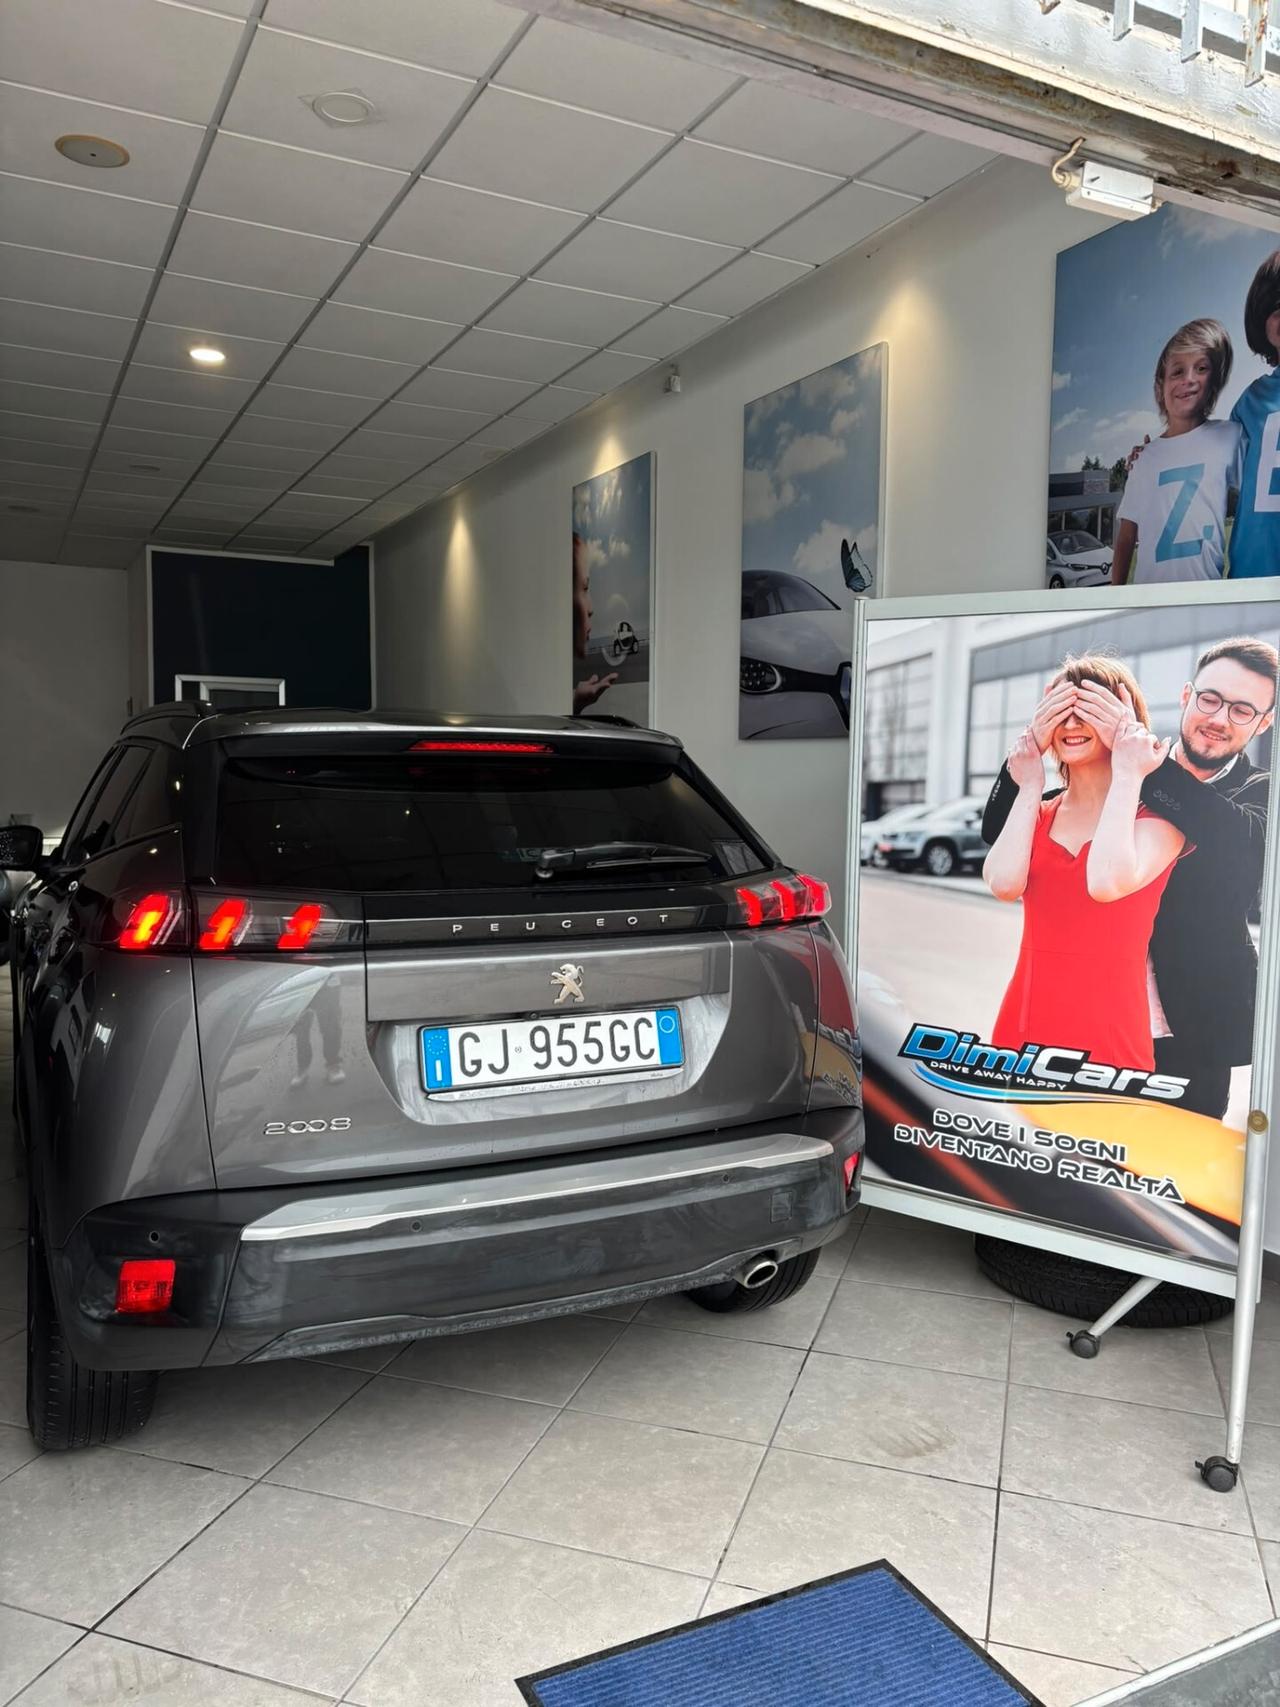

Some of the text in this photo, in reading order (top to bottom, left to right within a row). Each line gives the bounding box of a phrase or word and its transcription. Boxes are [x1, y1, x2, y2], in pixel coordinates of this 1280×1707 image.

[452, 914, 668, 933] PEUGEOT
[434, 1059, 443, 1081] I
[903, 1025, 1190, 1100] DimiCars
[930, 1061, 1068, 1091] DRIVE AWAY HAPPY
[263, 1117, 351, 1135] 2008
[933, 1109, 1127, 1163] DOVE I SOGNI
[894, 1124, 1186, 1204] DIVENTANO REALTÀ
